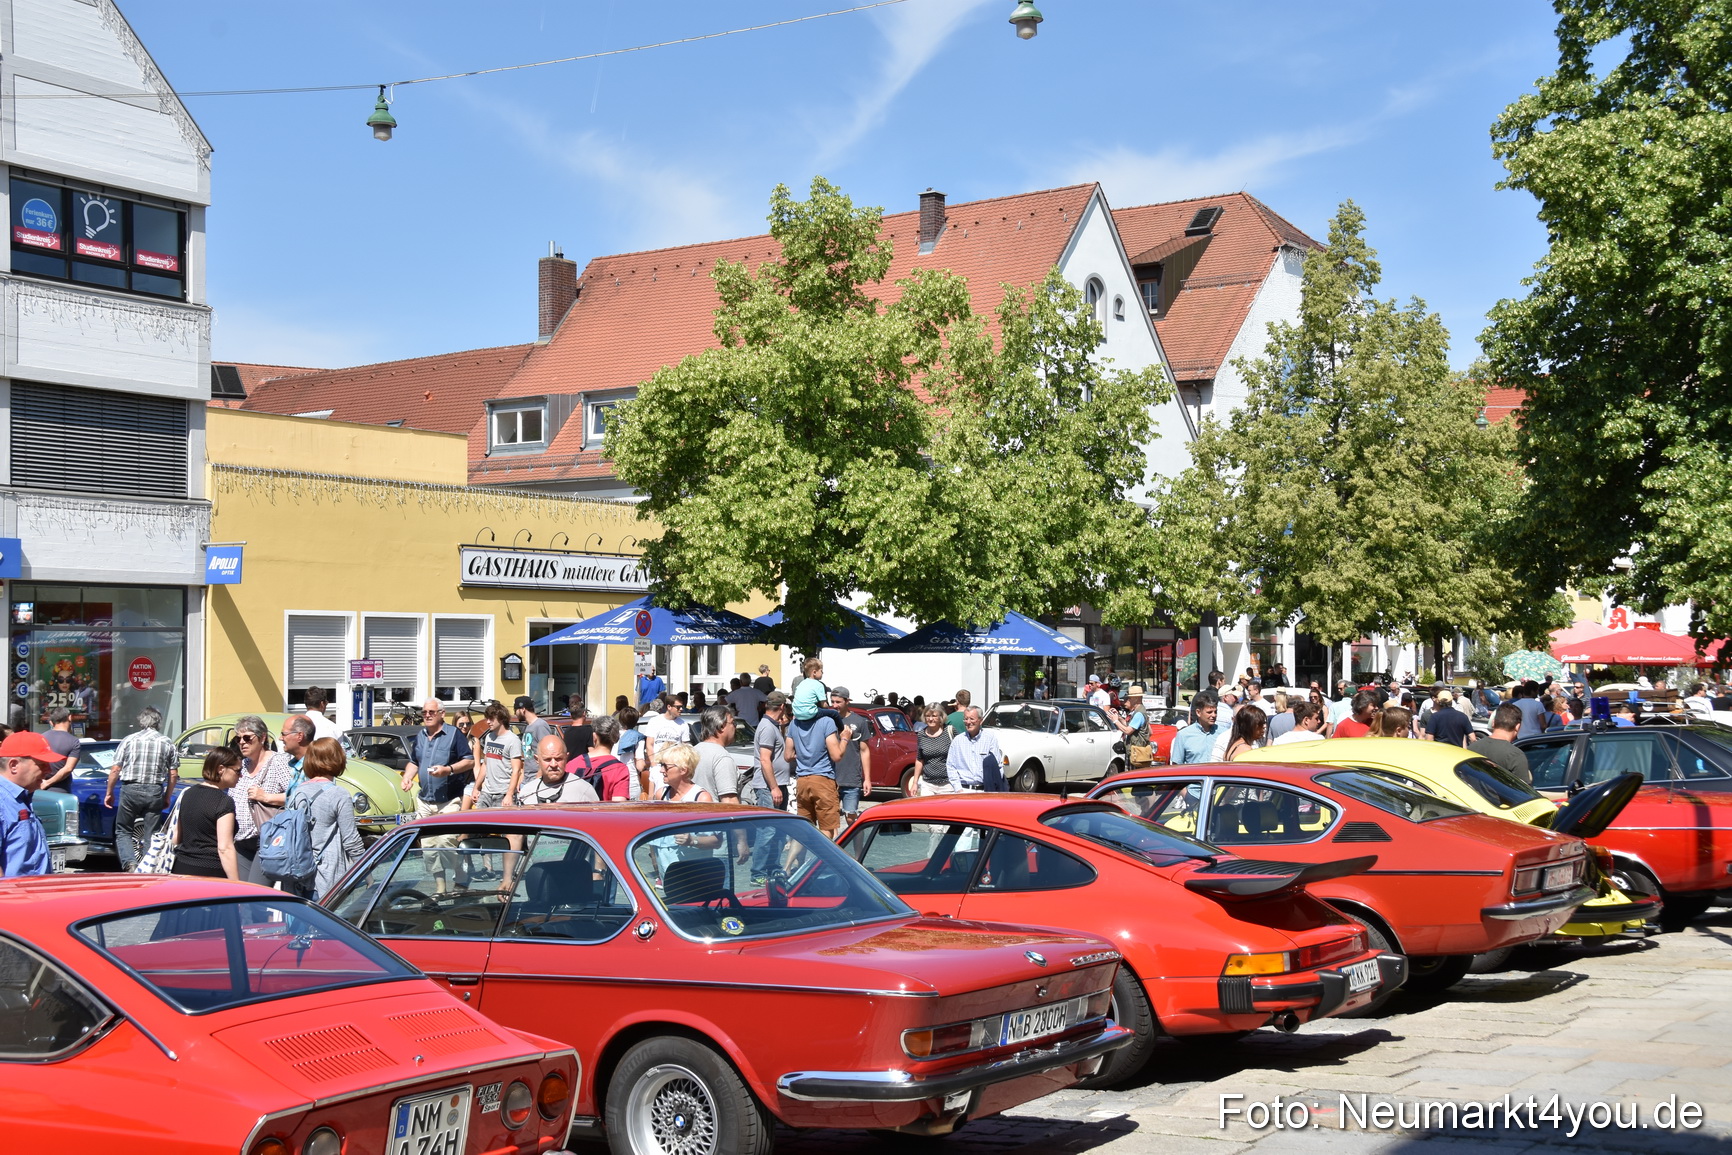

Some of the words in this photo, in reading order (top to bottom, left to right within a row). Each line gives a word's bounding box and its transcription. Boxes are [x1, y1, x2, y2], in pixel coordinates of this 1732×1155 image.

[25, 207, 54, 219] Ferienkurs
[16, 231, 51, 244] Studienkreis
[79, 243, 112, 255] Studienkreis
[138, 254, 169, 266] Studienkreis
[208, 555, 239, 570] APOLLO
[468, 555, 559, 581] GASTHAUS
[562, 565, 616, 582] mittlere
[48, 692, 84, 708] 25%
[1023, 1014, 1032, 1037] B
[410, 1100, 443, 1136] NM
